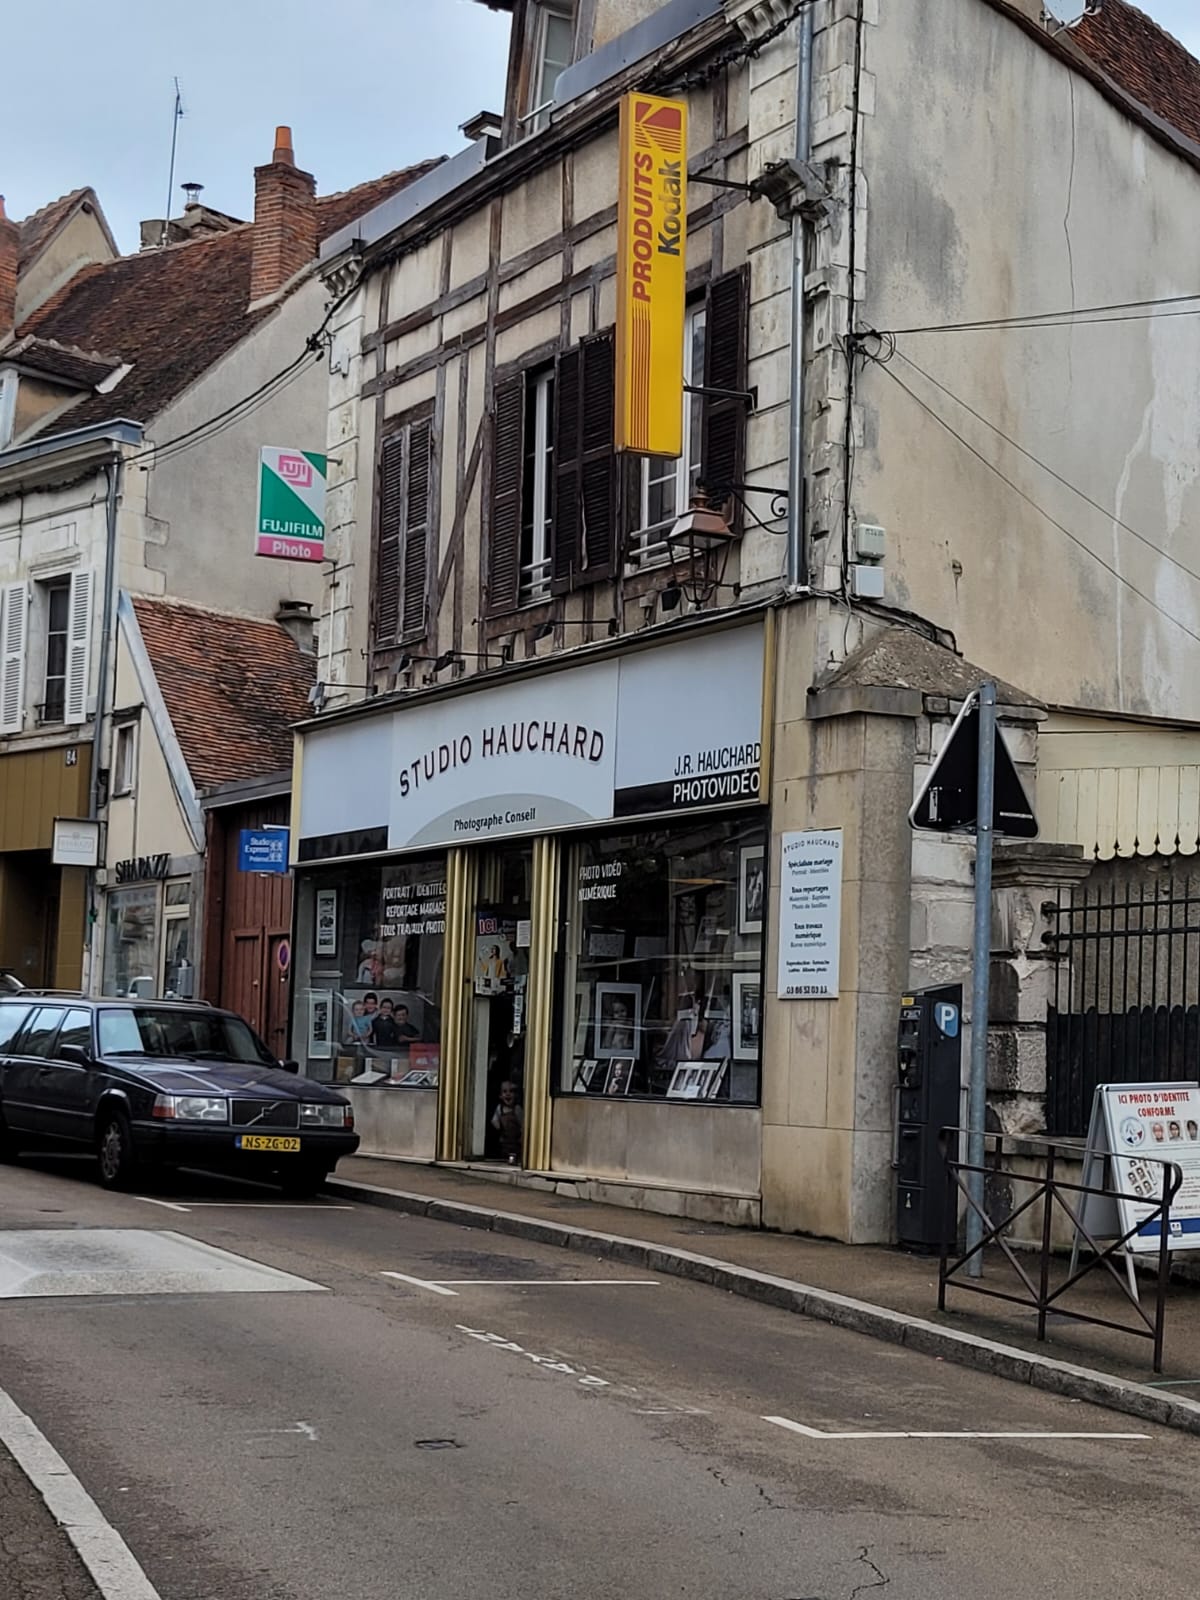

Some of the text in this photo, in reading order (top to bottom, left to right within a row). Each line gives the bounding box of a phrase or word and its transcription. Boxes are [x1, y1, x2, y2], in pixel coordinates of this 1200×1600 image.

[658, 159, 681, 256] Kodak
[632, 151, 653, 303] PRODUITS
[262, 519, 323, 537] FUJIFILM
[272, 541, 311, 558] Photo
[400, 721, 604, 797] STUDIO HAUCHARD
[674, 743, 761, 776] J.R. HAUCHARD
[673, 769, 760, 803] PHOTOVIDÉO
[454, 808, 536, 832] Photographe Conseil
[579, 860, 621, 880] PHOTO VIDÉO
[381, 925, 396, 937] TOUS
[425, 920, 446, 934] PHOTO
[480, 918, 498, 934] ICI
[941, 1005, 955, 1031] P
[1118, 1094, 1128, 1104] ICI
[1129, 1093, 1152, 1104] PHOTO
[1138, 1106, 1175, 1118] CONFORME
[245, 1137, 297, 1150] NS-ZG-02
[455, 1323, 611, 1386] PAYANT
